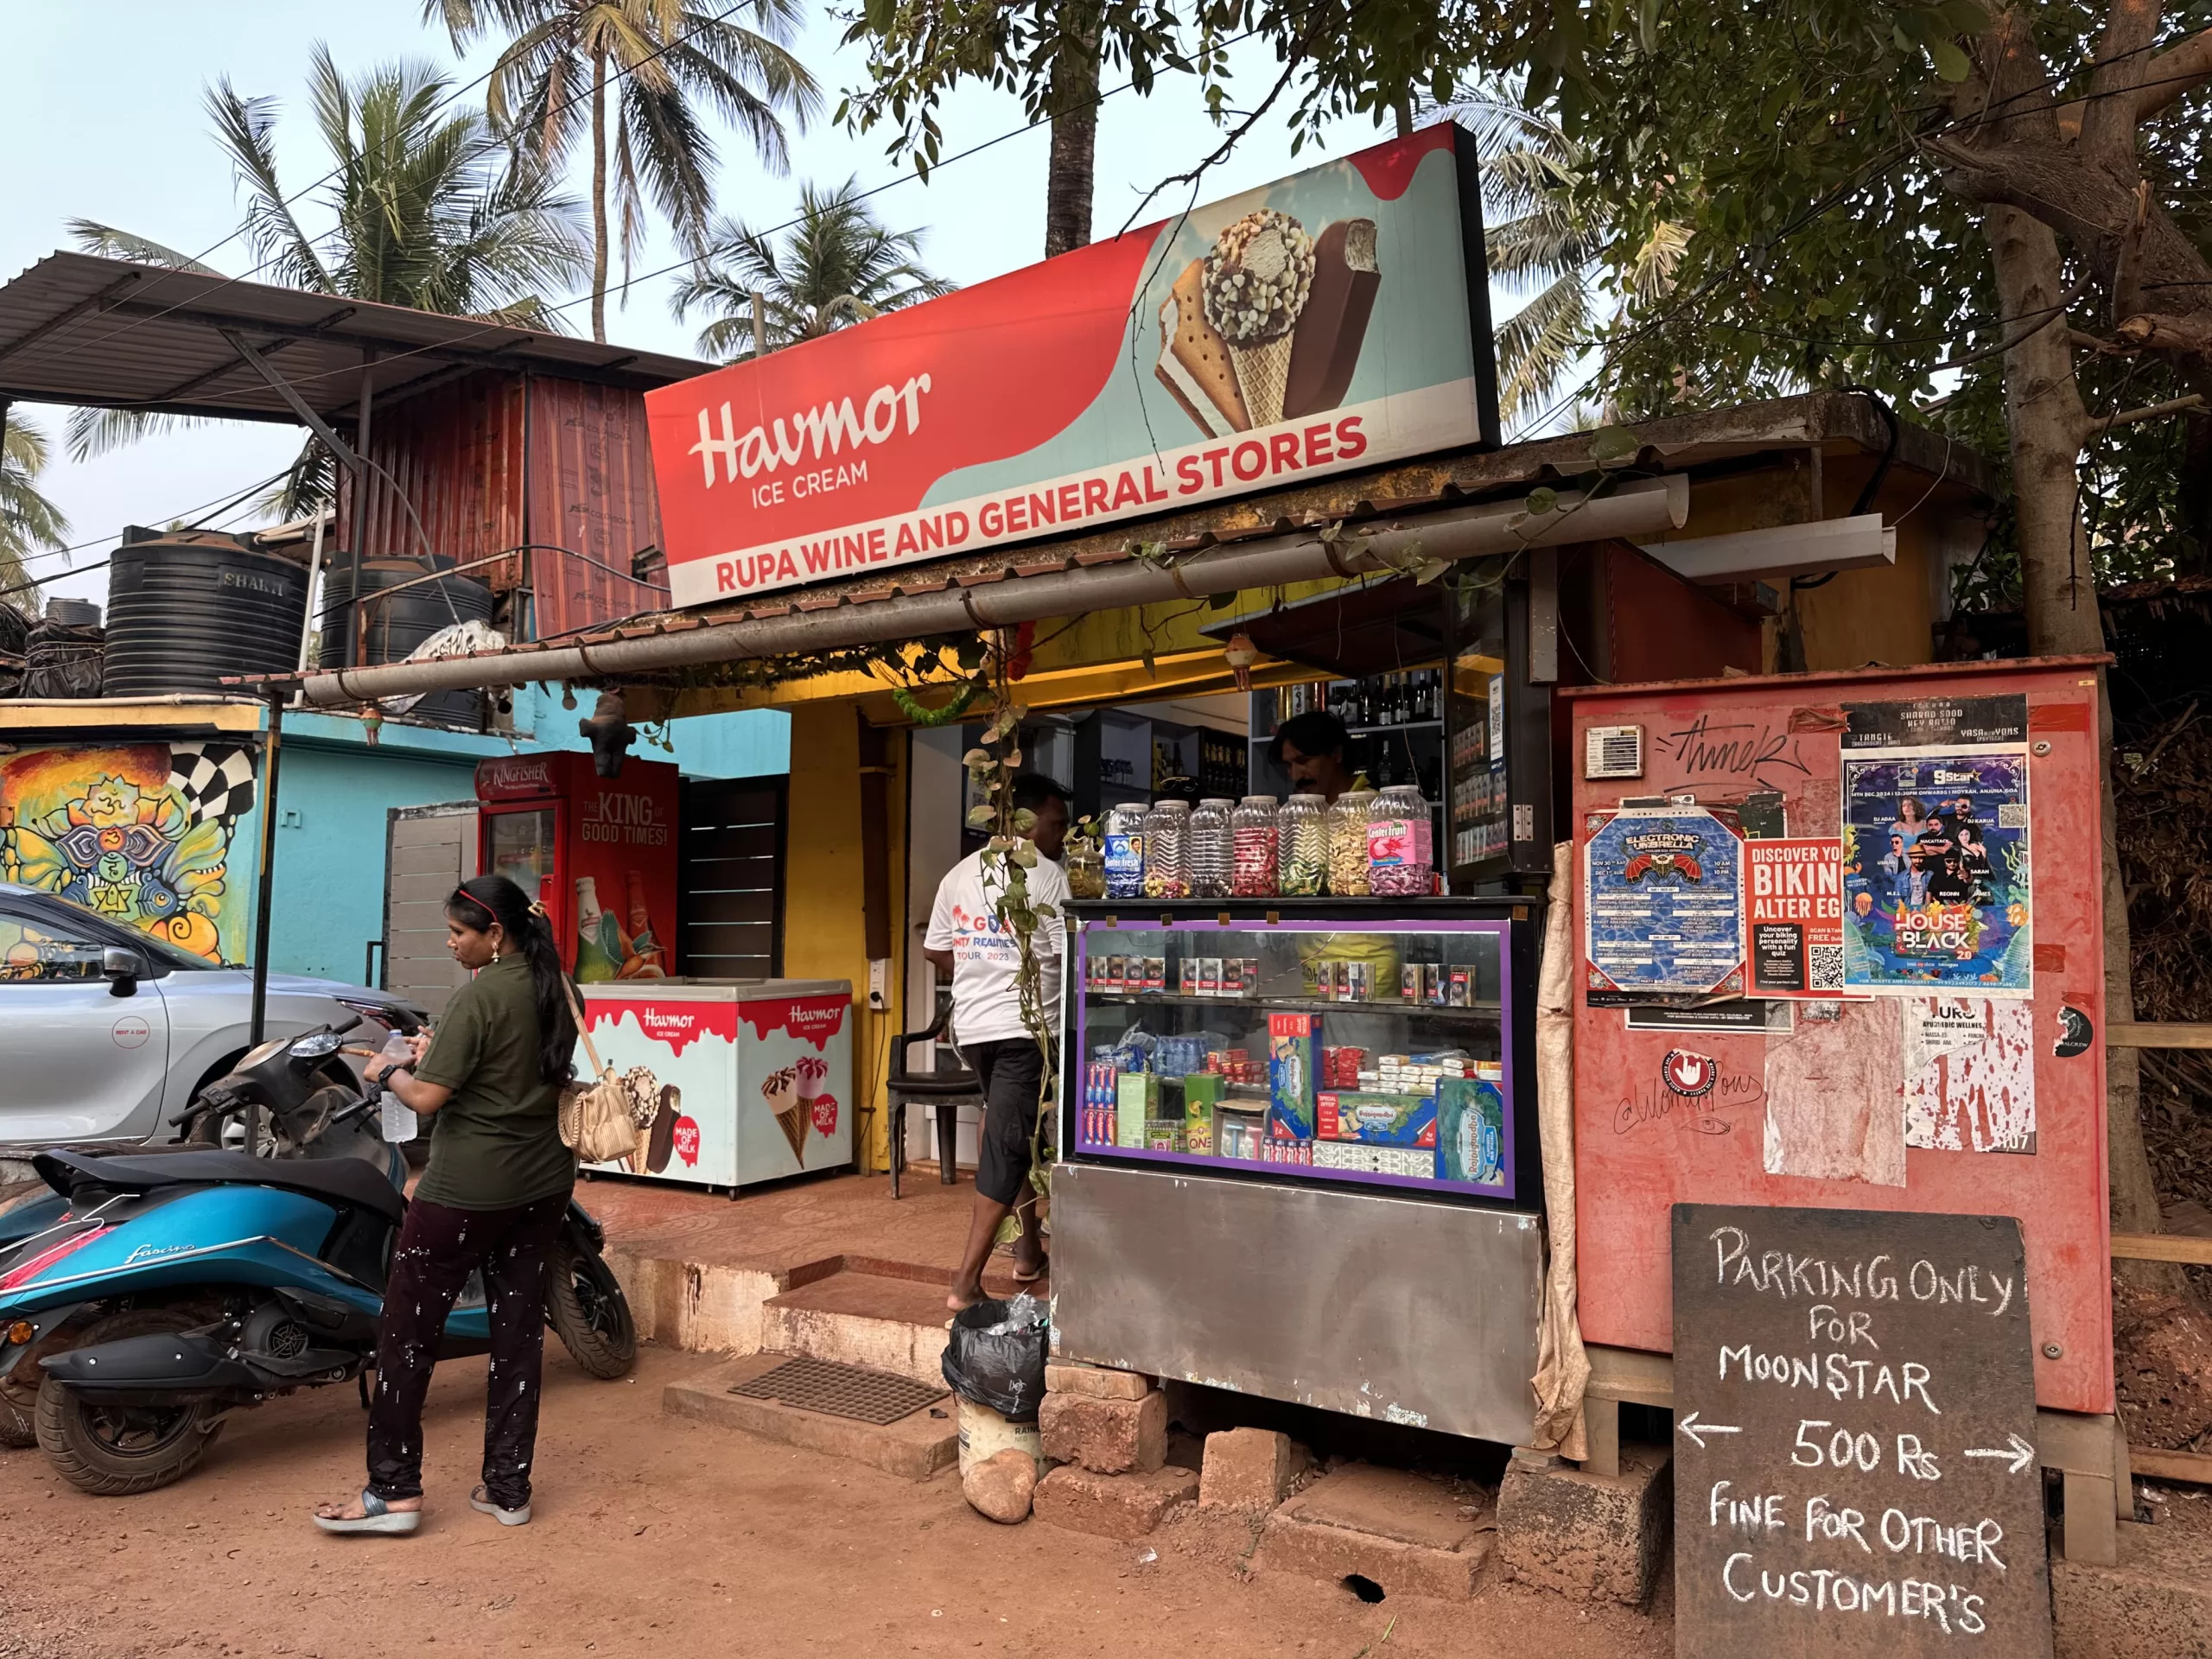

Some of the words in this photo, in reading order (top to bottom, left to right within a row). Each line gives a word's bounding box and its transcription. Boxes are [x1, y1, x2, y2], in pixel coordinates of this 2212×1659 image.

[688, 373, 931, 489] Havmor
[752, 481, 785, 509] ICE
[792, 460, 868, 499] CREAM
[716, 549, 799, 593] RUPA
[800, 528, 887, 574] WINE
[894, 510, 969, 556] AND
[980, 466, 1168, 538] GENERAL
[1176, 416, 1368, 495] STORES
[493, 762, 550, 787] KINGFISHER
[584, 800, 598, 812] THE
[599, 792, 652, 825] KING
[582, 823, 619, 842] GOOD
[624, 825, 668, 845] TIMES!
[1752, 847, 1819, 862] DISCOVER
[1822, 846, 1842, 861] YO
[1754, 862, 1842, 896] BIKIN
[1753, 898, 1810, 918] ALTER
[1895, 913, 1966, 931] HOUSE
[1903, 931, 1970, 949] BLACK
[957, 951, 981, 960] TOUR
[987, 952, 1009, 961] 2023
[643, 1007, 695, 1028] Havmor
[788, 1005, 841, 1023] Havmor
[814, 1102, 836, 1113] MADE
[676, 1127, 697, 1137] MADE
[816, 1116, 834, 1126] MILK
[677, 1144, 696, 1154] MILK
[1468, 1114, 1478, 1173] Rajnigandha
[124, 1244, 195, 1264] fascino
[1710, 1226, 1898, 1298] PARKING
[1910, 1260, 2012, 1316] ONLY
[1809, 1305, 1878, 1349] FOR
[1791, 1421, 1880, 1471] 500
[1710, 1481, 1785, 1528] FINE
[1805, 1495, 1872, 1554] FOR
[1880, 1509, 2006, 1569] OTHER
[1723, 1553, 1986, 1634] CUSTOMER'S
